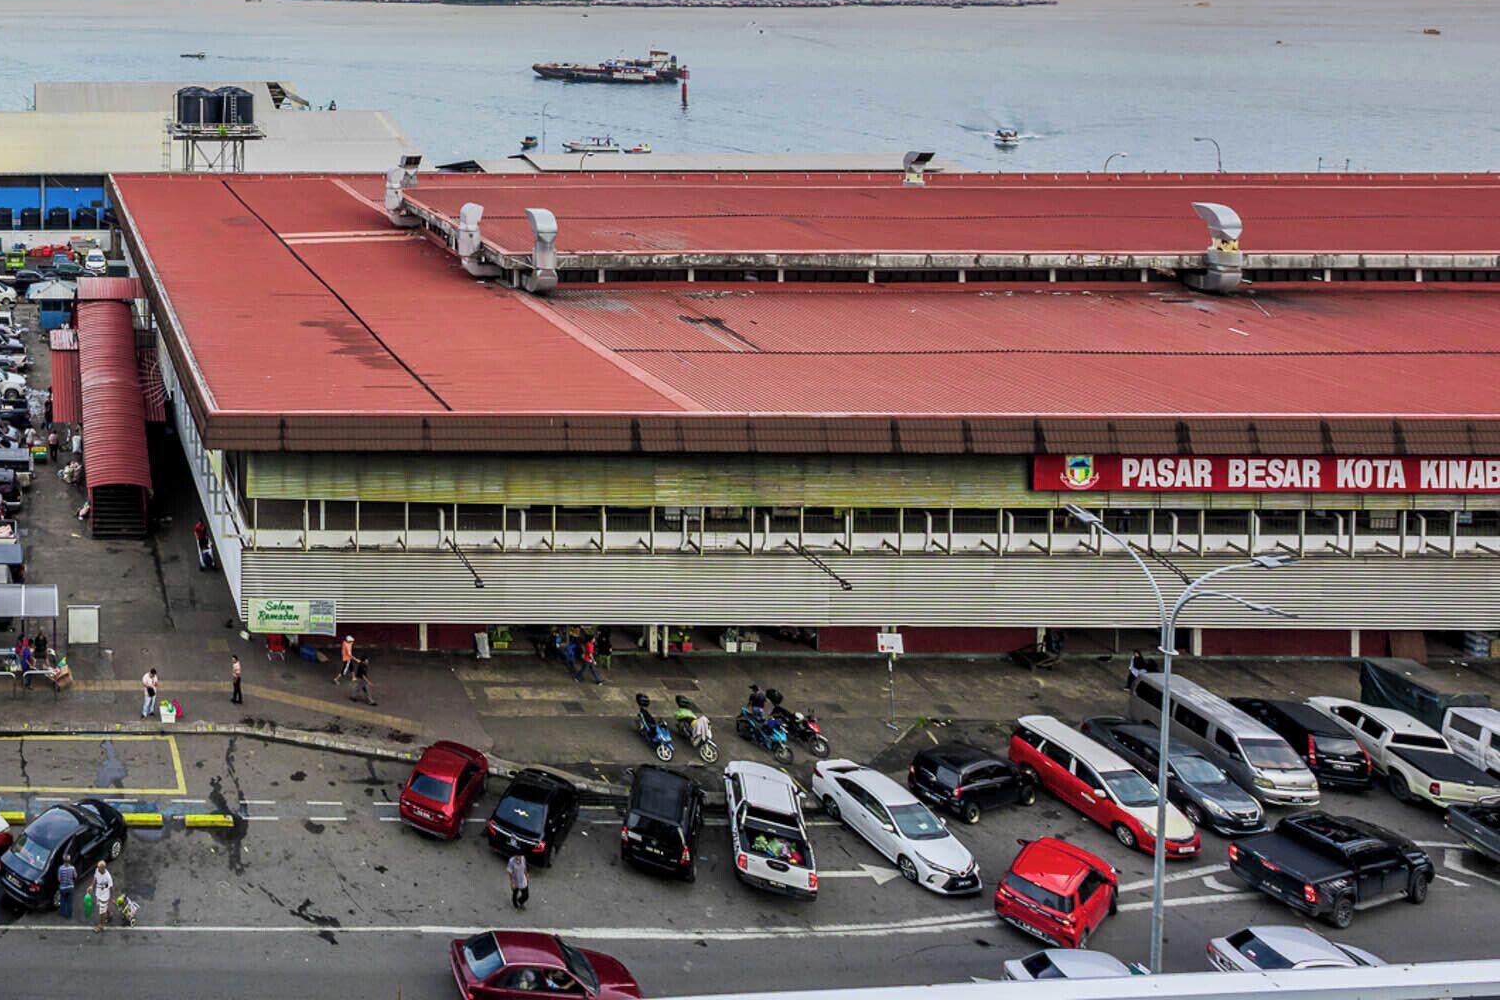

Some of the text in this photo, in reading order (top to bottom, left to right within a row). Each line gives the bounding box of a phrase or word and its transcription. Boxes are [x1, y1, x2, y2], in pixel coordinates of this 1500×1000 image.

[1121, 458, 1500, 489] PASAR BESAR KOTA KINAB
[265, 600, 294, 611] Salam
[258, 610, 300, 621] Ramadan
